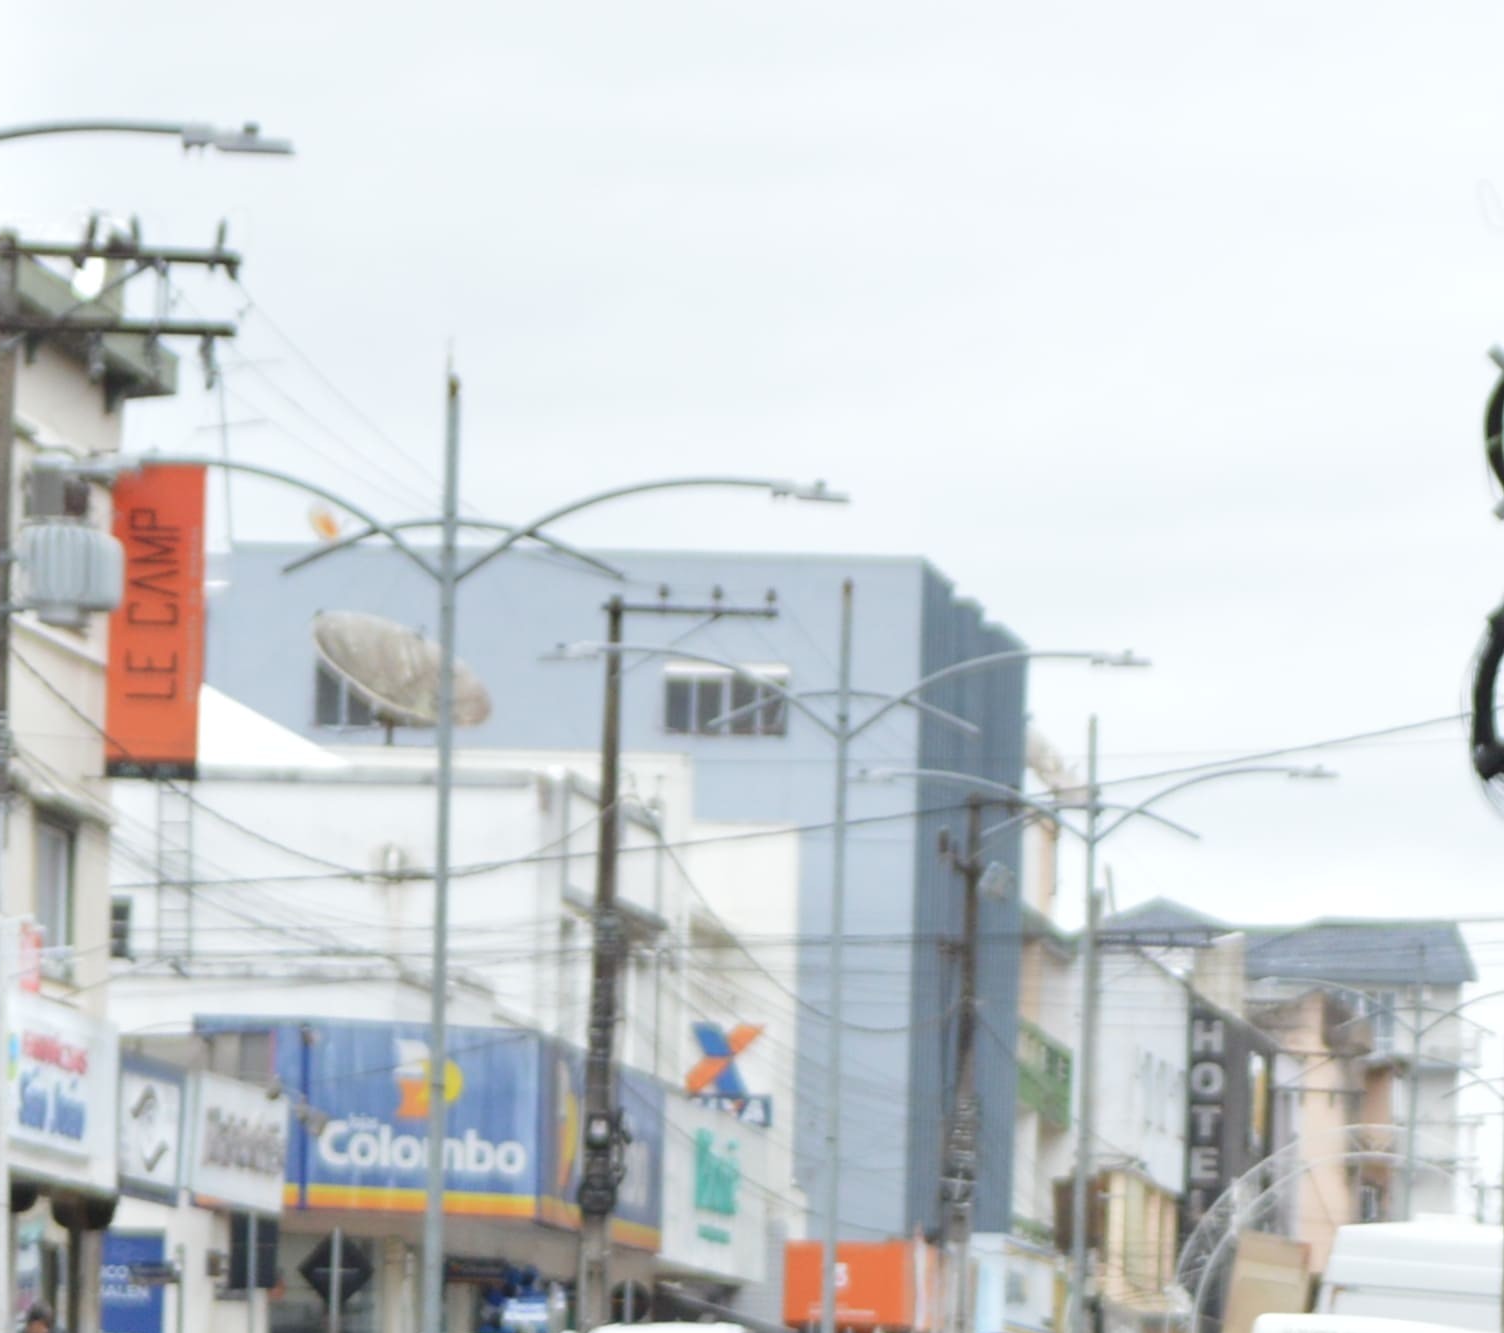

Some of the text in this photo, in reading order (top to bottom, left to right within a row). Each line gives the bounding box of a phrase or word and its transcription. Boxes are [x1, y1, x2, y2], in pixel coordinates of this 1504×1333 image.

[126, 507, 181, 703] LE CAMP
[318, 1117, 527, 1177] Colombo
